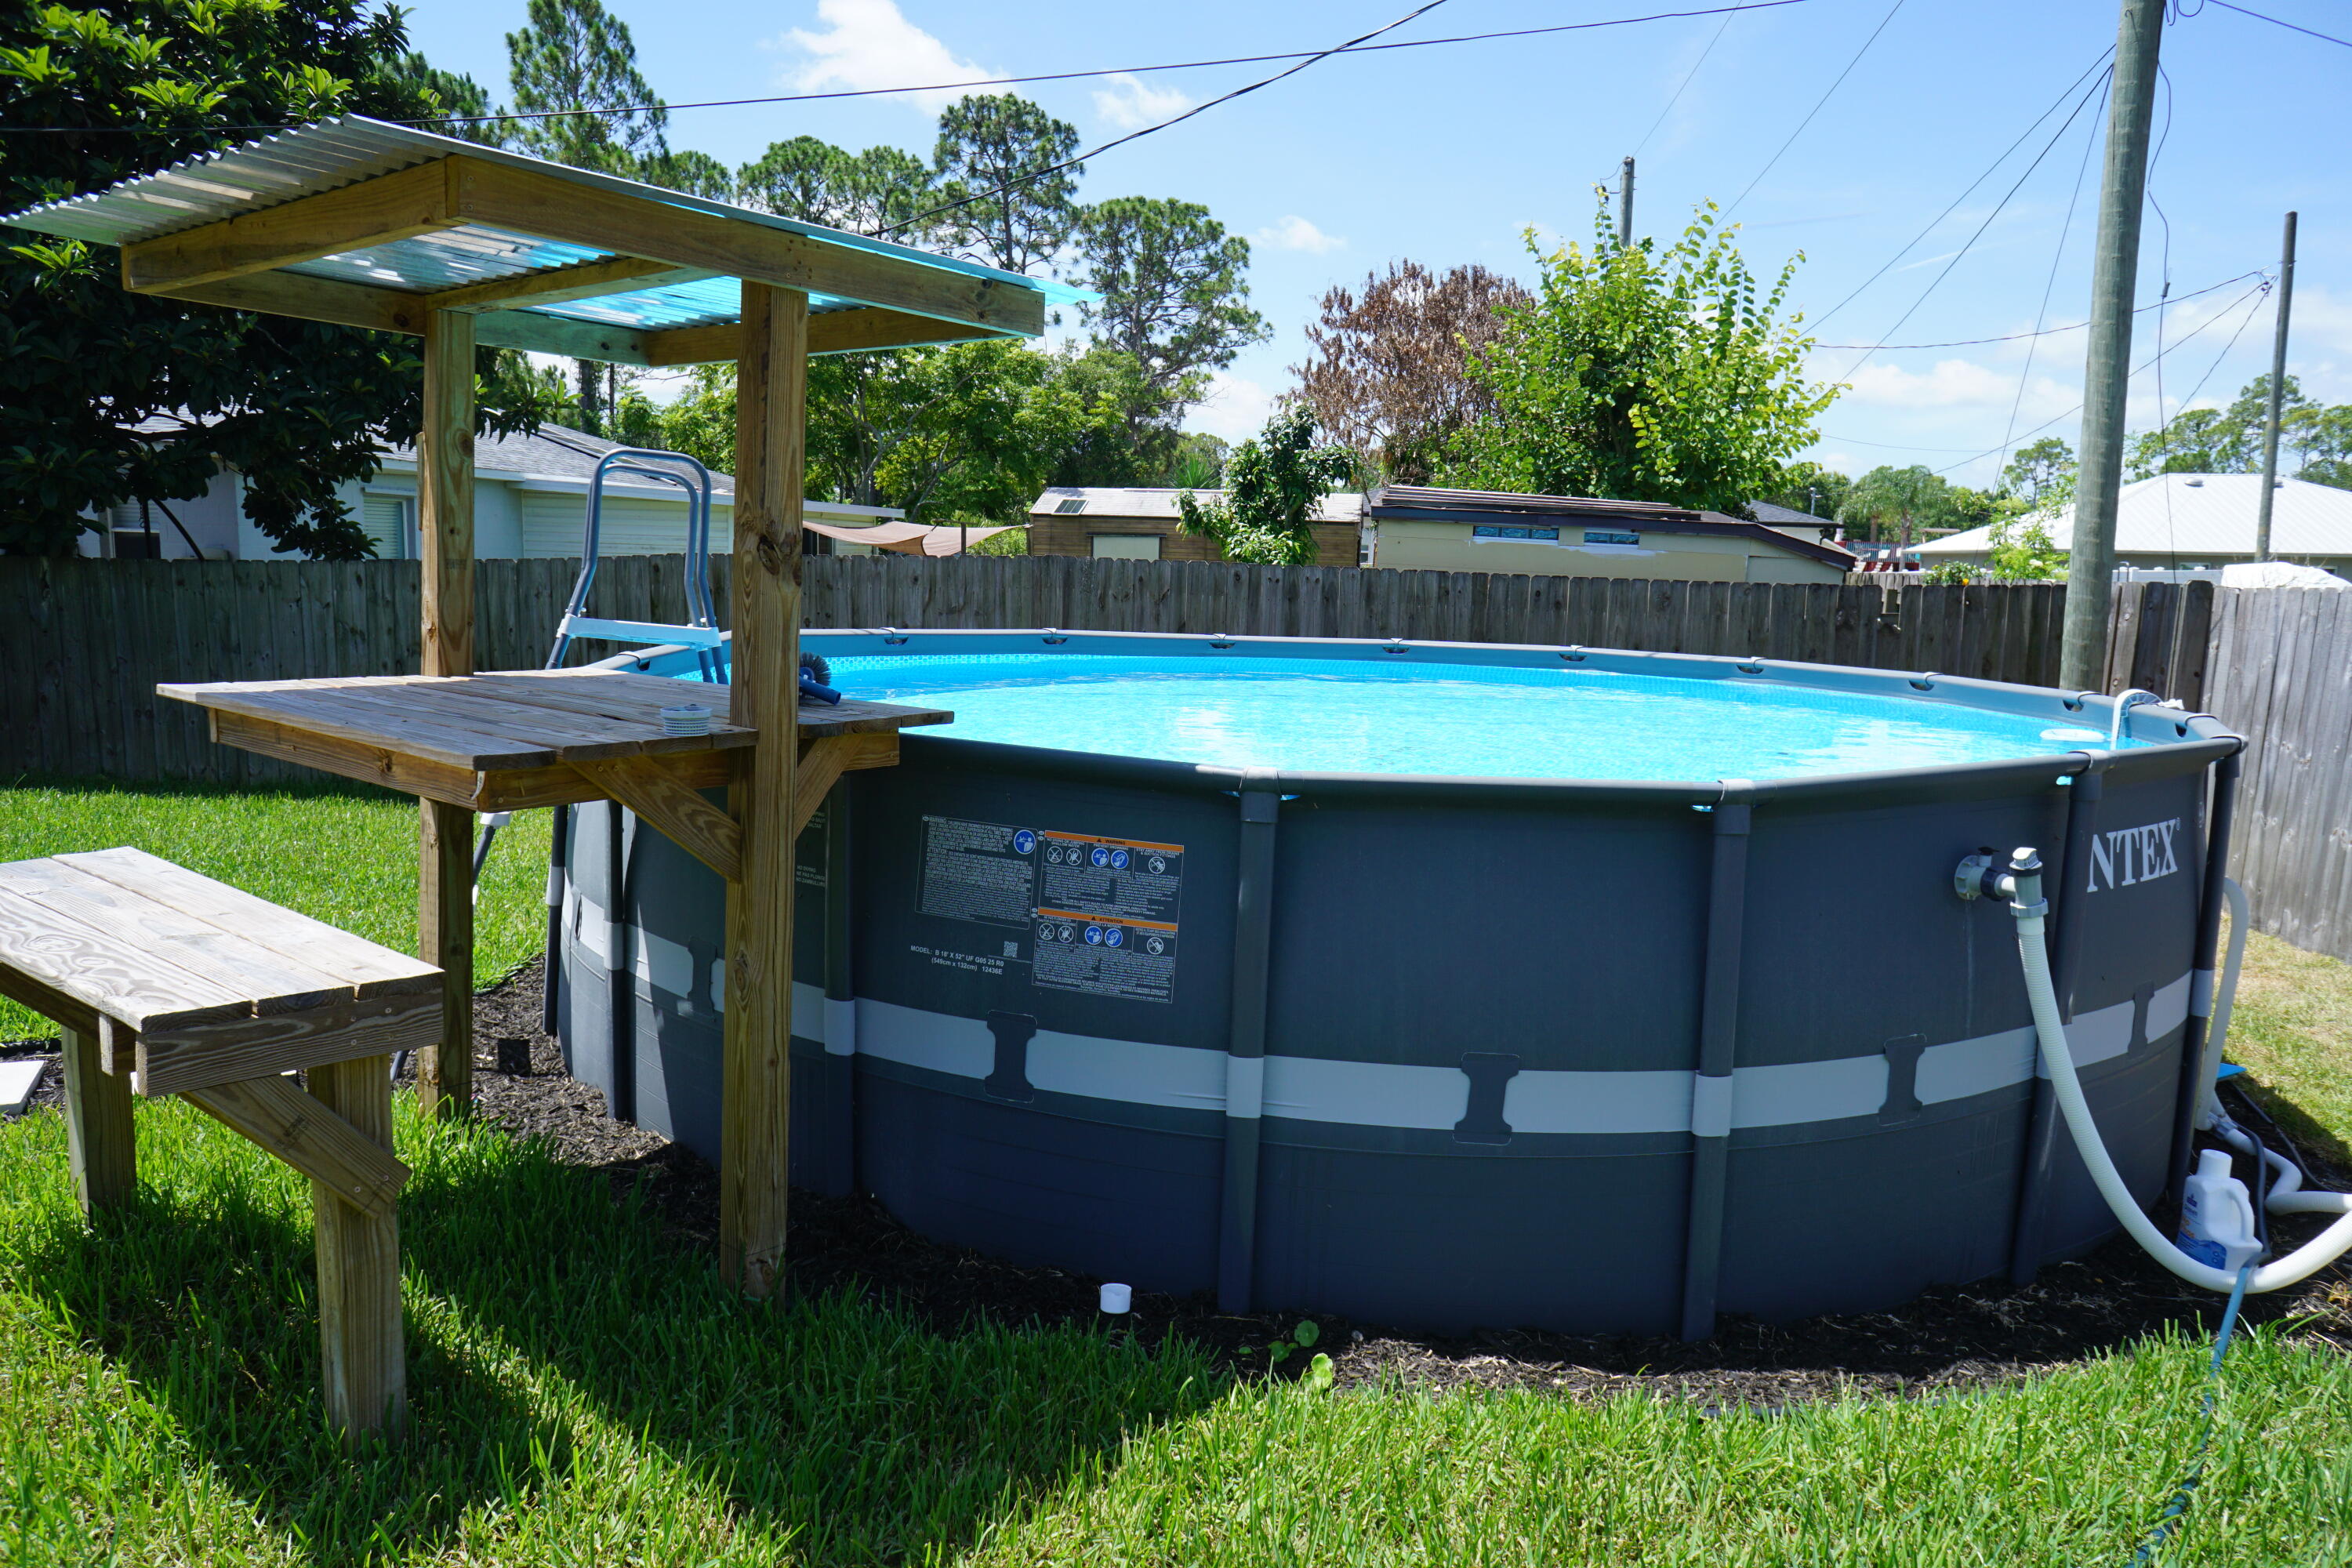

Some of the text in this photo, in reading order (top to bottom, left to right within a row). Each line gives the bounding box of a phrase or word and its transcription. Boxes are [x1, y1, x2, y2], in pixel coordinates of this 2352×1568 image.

[2087, 818, 2178, 892] NTEX
[910, 945, 933, 955] MODEL:
[931, 957, 951, 966] (549cm
[957, 961, 978, 972] 132cm)
[982, 966, 1003, 975] 12436E
